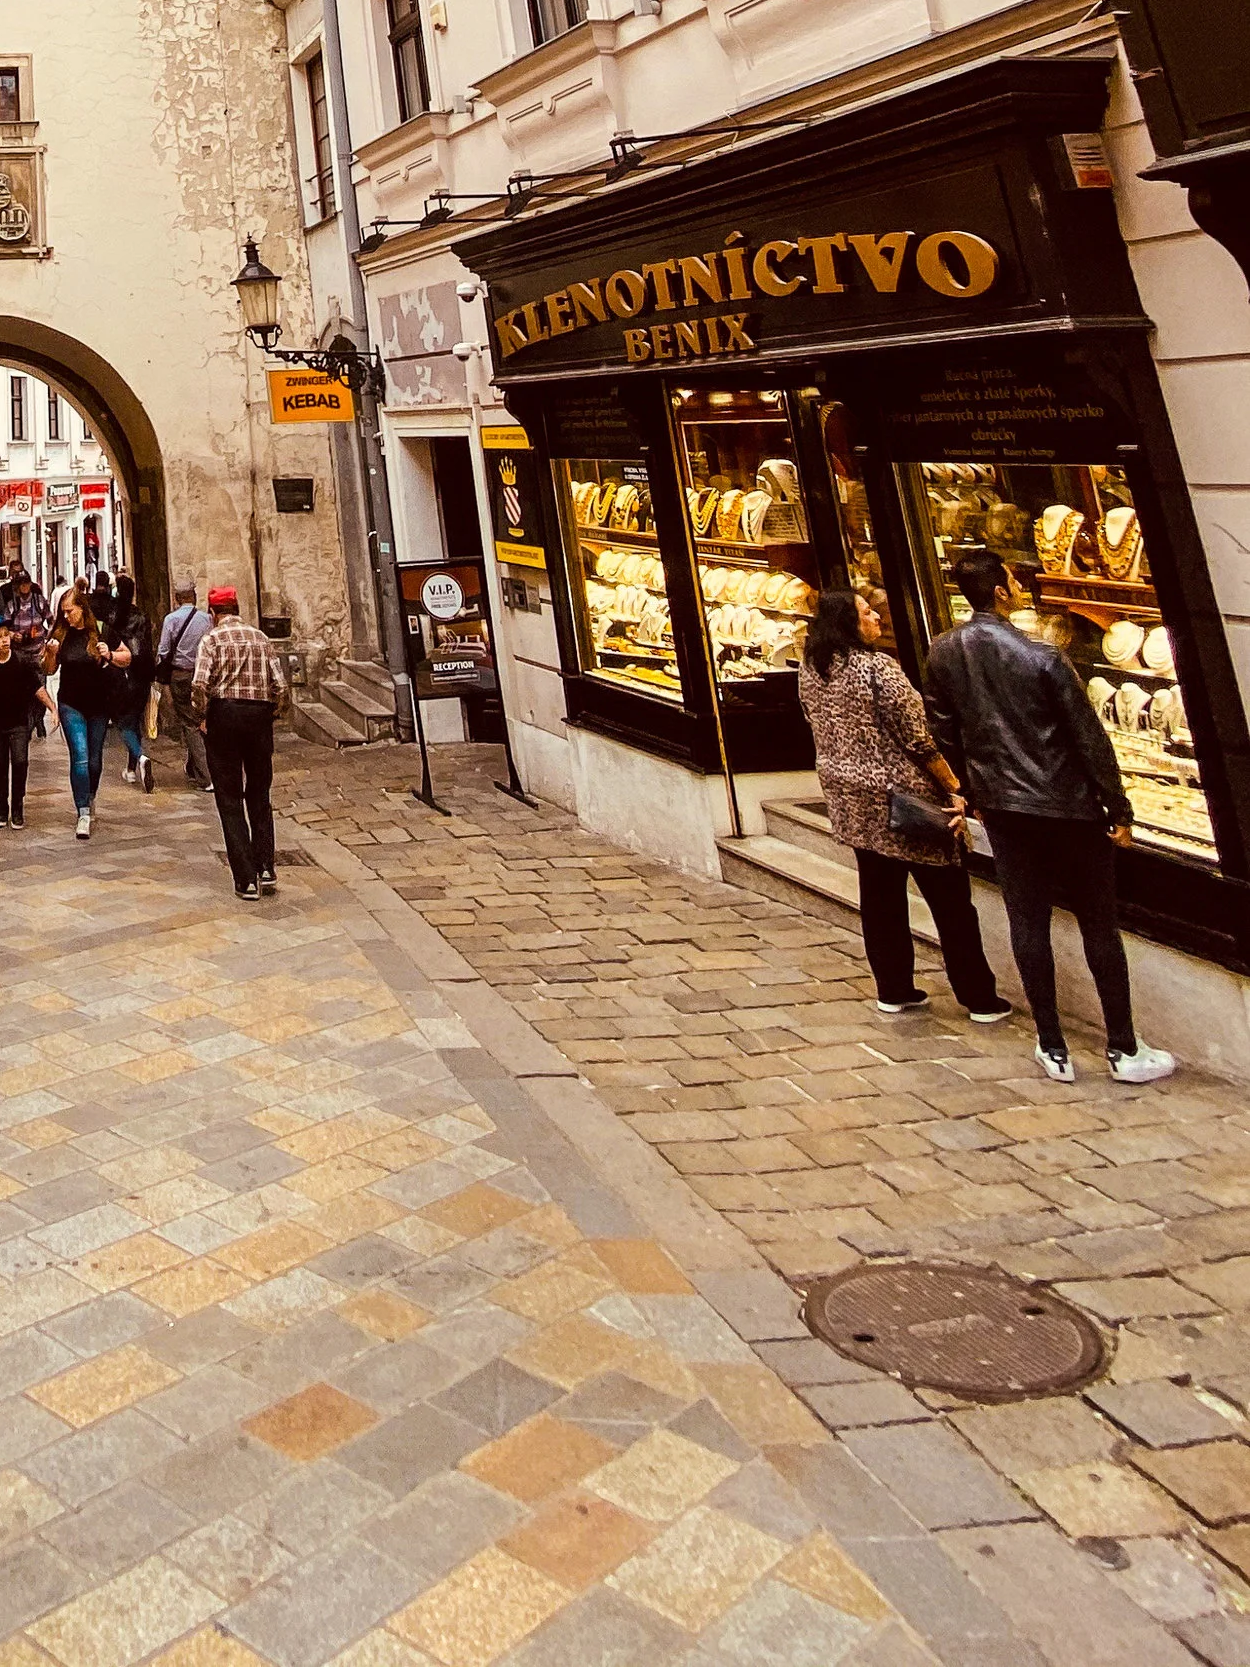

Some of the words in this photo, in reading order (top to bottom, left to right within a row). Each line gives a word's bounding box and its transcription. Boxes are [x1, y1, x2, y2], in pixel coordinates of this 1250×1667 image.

[494, 230, 998, 359] KLENOTNÍCTVO
[622, 313, 757, 362] BENIX
[285, 376, 333, 386] ZWINGER
[283, 394, 340, 412] KEBAB
[428, 584, 455, 595] V.I.P.
[433, 661, 474, 672] RECEPTION
